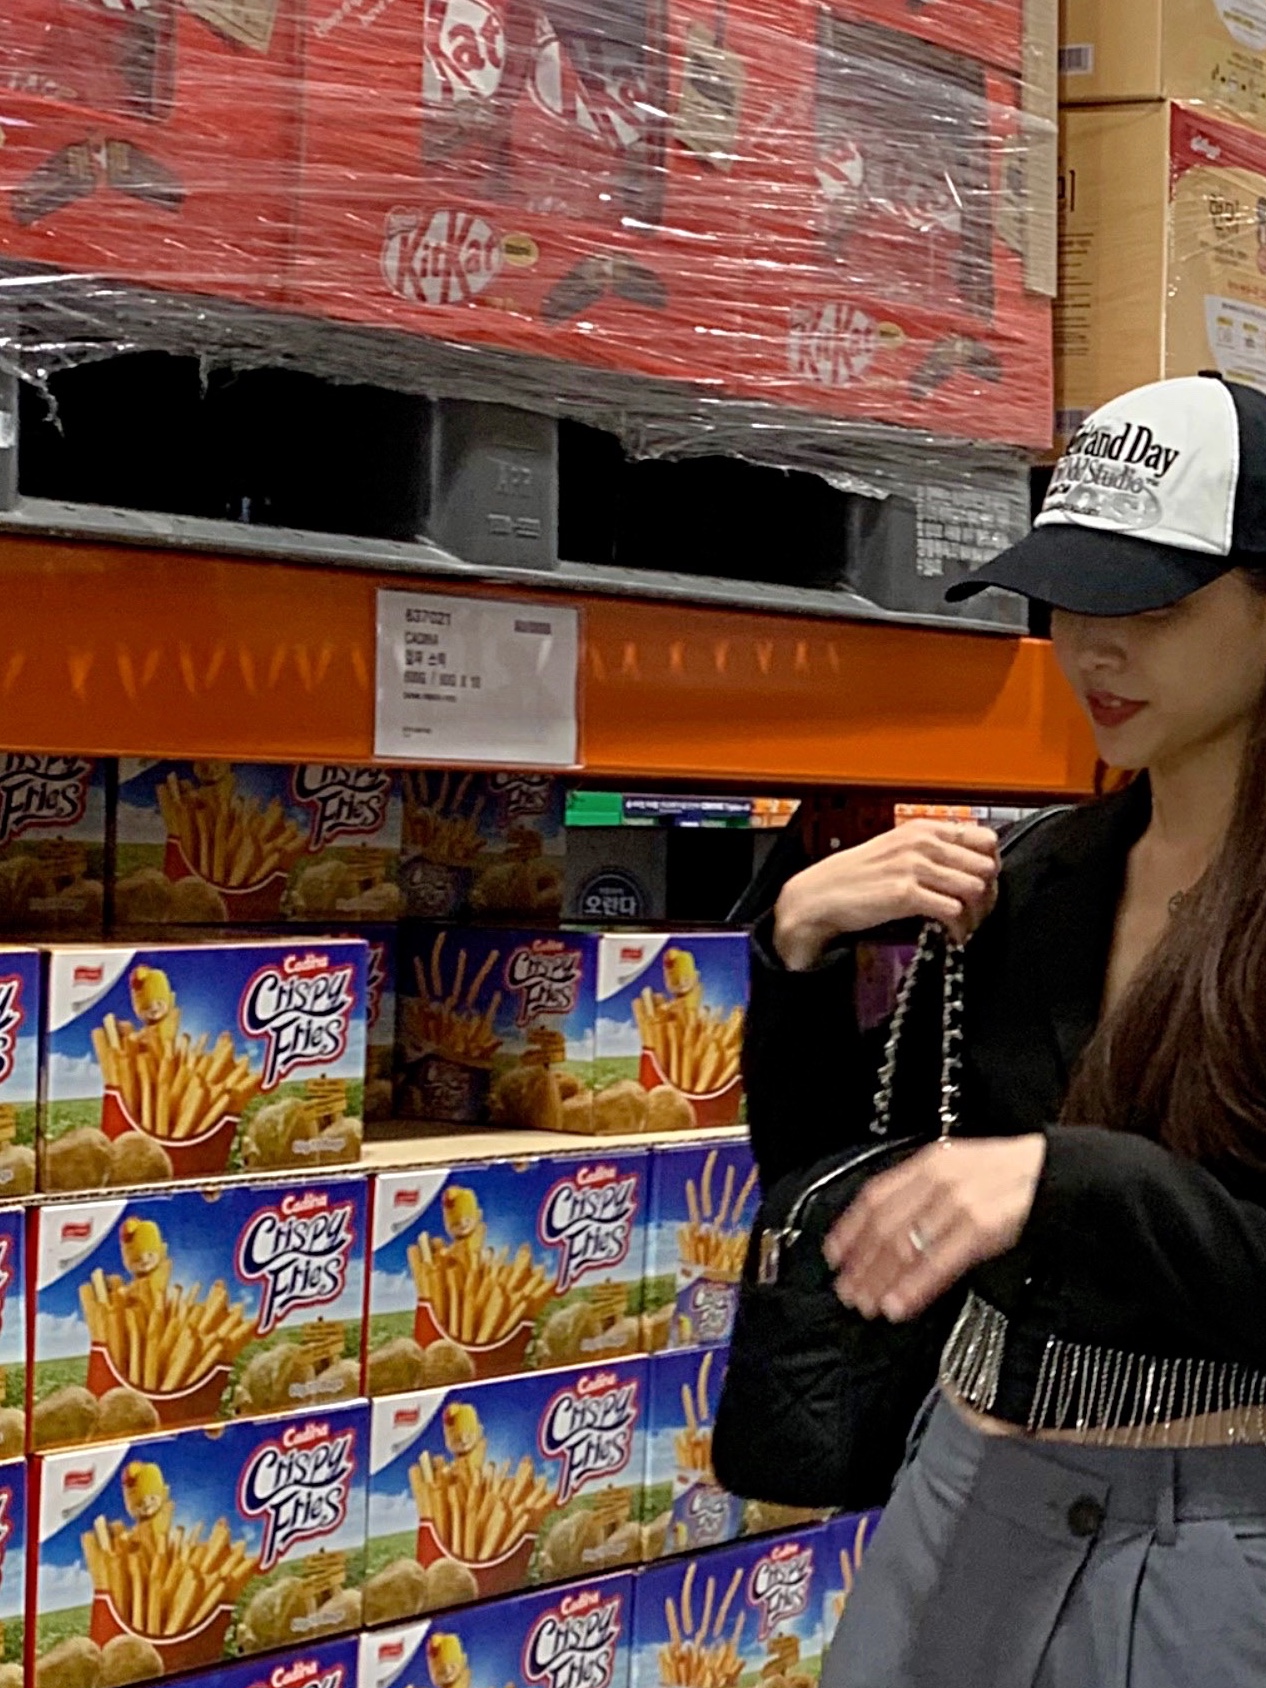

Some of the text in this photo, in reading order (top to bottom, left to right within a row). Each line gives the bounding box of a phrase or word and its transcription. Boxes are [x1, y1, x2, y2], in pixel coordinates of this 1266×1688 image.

[1125, 425, 1180, 478] Day
[246, 967, 351, 1031] Crispy
[264, 1016, 342, 1088] Fries
[244, 1206, 350, 1270] Crispy
[545, 1179, 633, 1241] Crispy
[560, 1226, 624, 1292] Fries
[262, 1255, 340, 1331] Fries
[545, 1386, 634, 1450] Crispy
[244, 1437, 351, 1509] Crispy
[560, 1431, 625, 1500] Fries
[262, 1488, 340, 1567] Fries
[530, 1605, 618, 1676] Crispy
